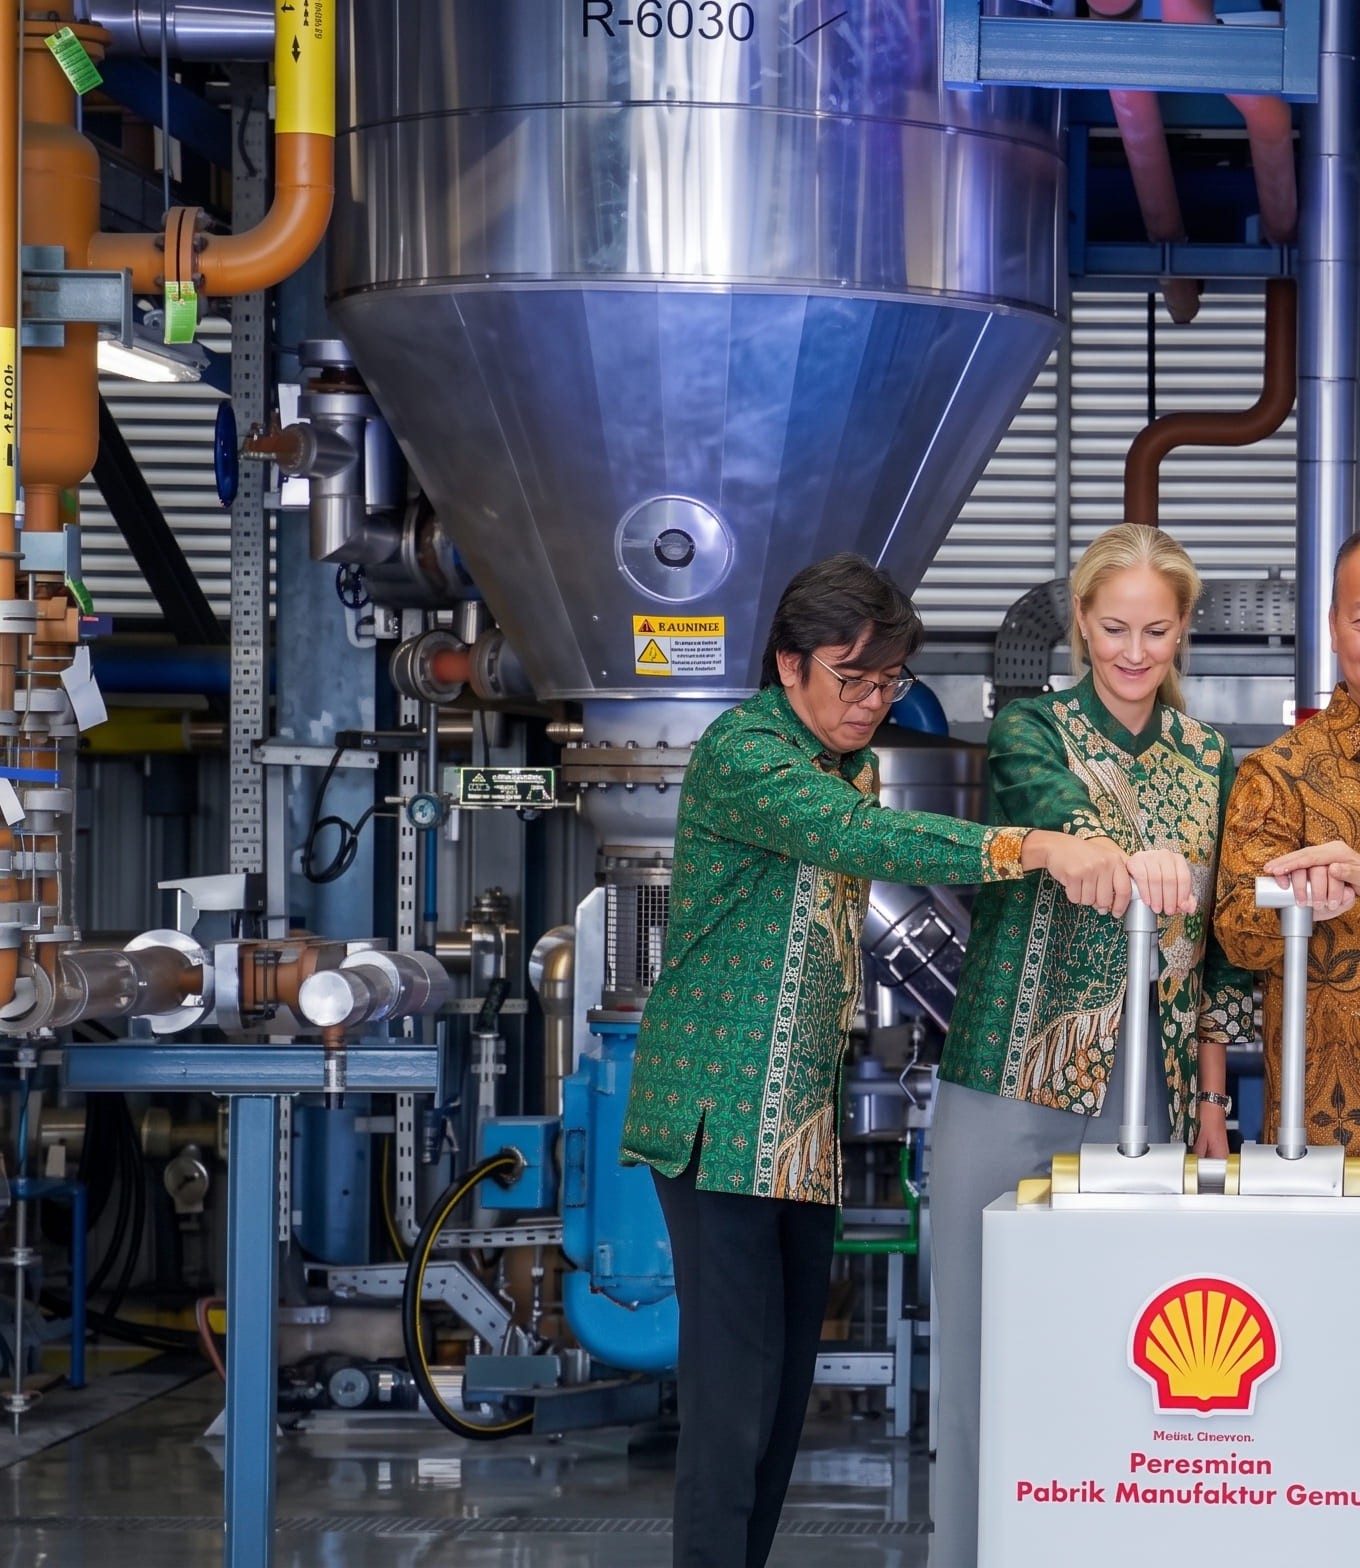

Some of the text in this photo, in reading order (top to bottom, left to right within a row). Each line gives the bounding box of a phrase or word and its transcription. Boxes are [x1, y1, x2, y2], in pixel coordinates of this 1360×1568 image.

[583, 0, 754, 41] R-6030
[1130, 1452, 1272, 1475] Peresmian
[1017, 1480, 1105, 1503] Pabrik
[1115, 1481, 1277, 1505] Manufaktur
